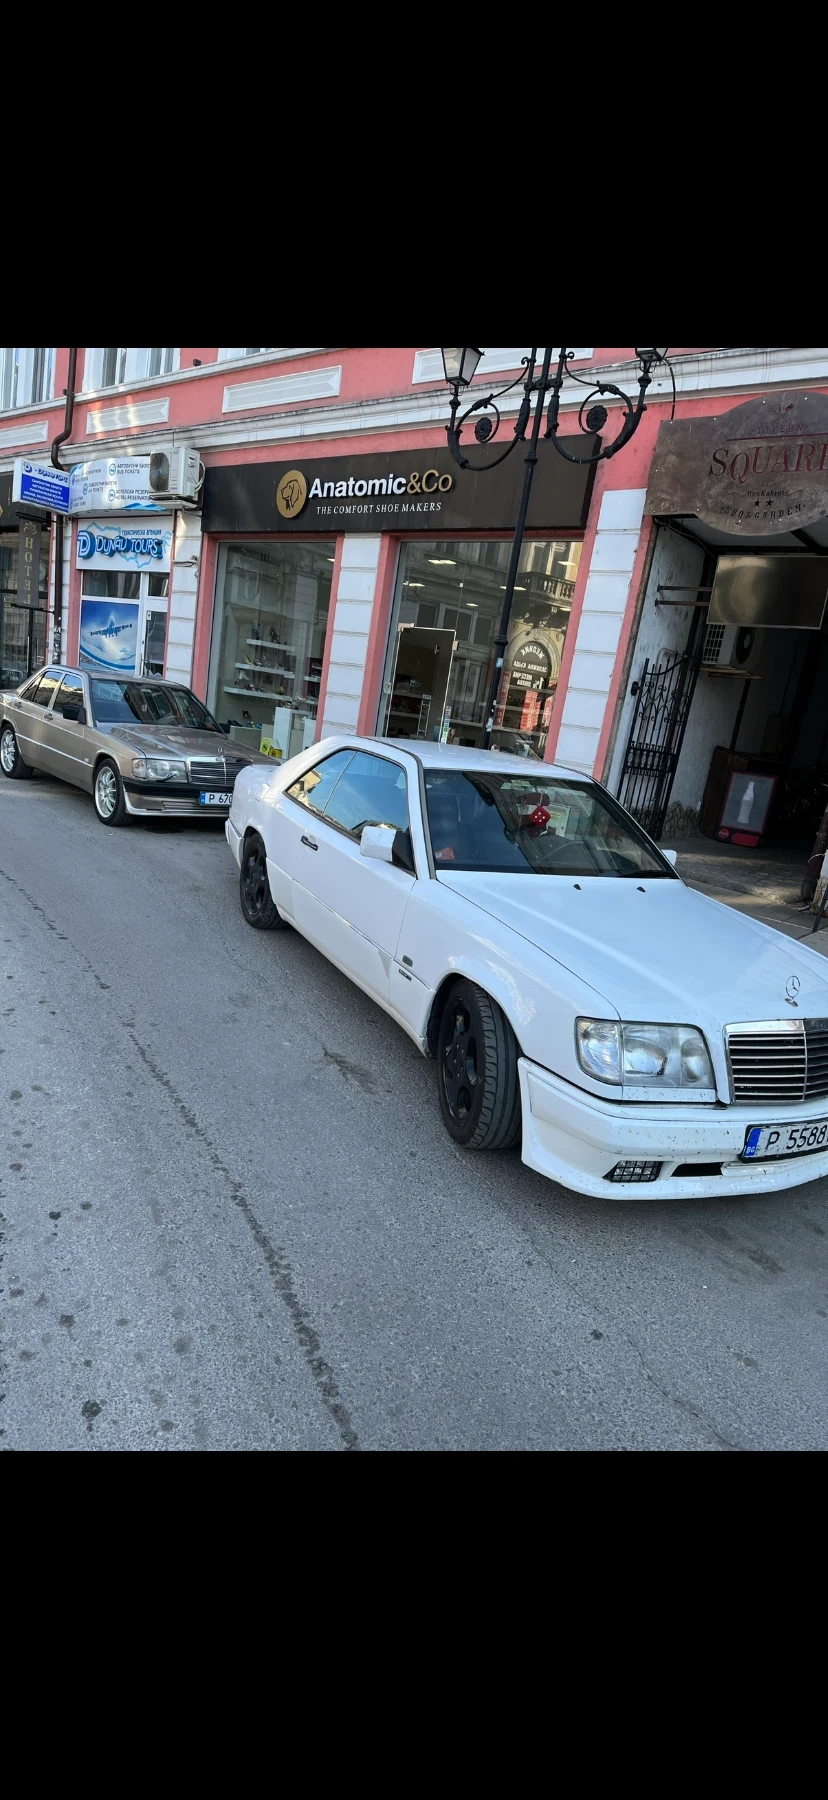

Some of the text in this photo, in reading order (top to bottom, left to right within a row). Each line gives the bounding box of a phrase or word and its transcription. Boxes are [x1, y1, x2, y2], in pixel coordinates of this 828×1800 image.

[308, 469, 453, 498] Anatomic&Co
[316, 502, 442, 515] THE COMFORT SHOE MAKERS
[209, 794, 215, 802] P
[765, 1124, 828, 1150] P 5588
[746, 1146, 756, 1154] BG
